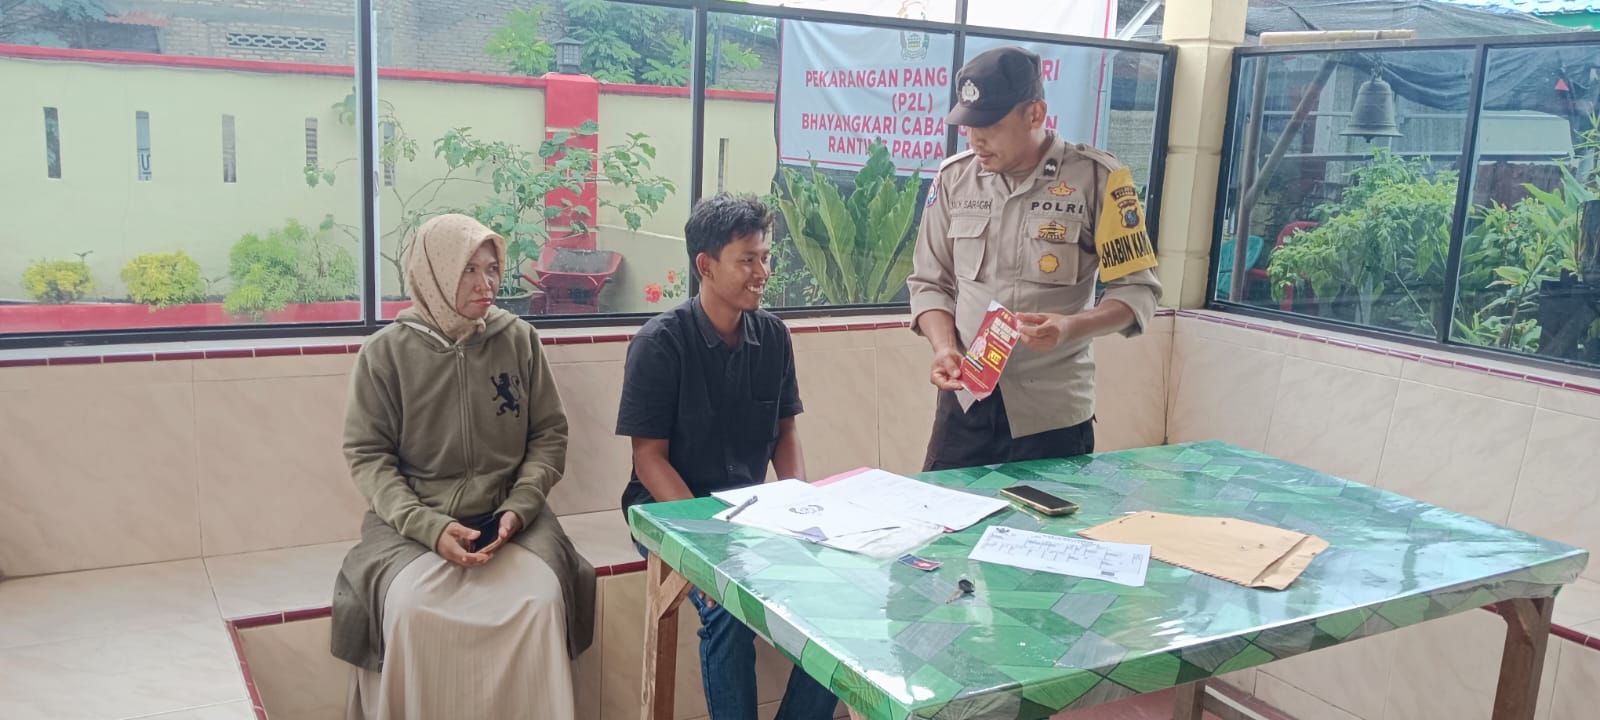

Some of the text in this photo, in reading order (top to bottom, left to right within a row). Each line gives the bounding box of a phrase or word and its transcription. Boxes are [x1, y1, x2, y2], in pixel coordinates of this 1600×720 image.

[805, 67, 947, 88] PEKARANGAN PANG
[892, 92, 933, 114] (P2L)
[802, 113, 967, 137] BHAYANGKARI CABAG
[828, 135, 888, 156] RANTI
[892, 139, 944, 160] PRAPA
[1031, 201, 1085, 214] POLRI
